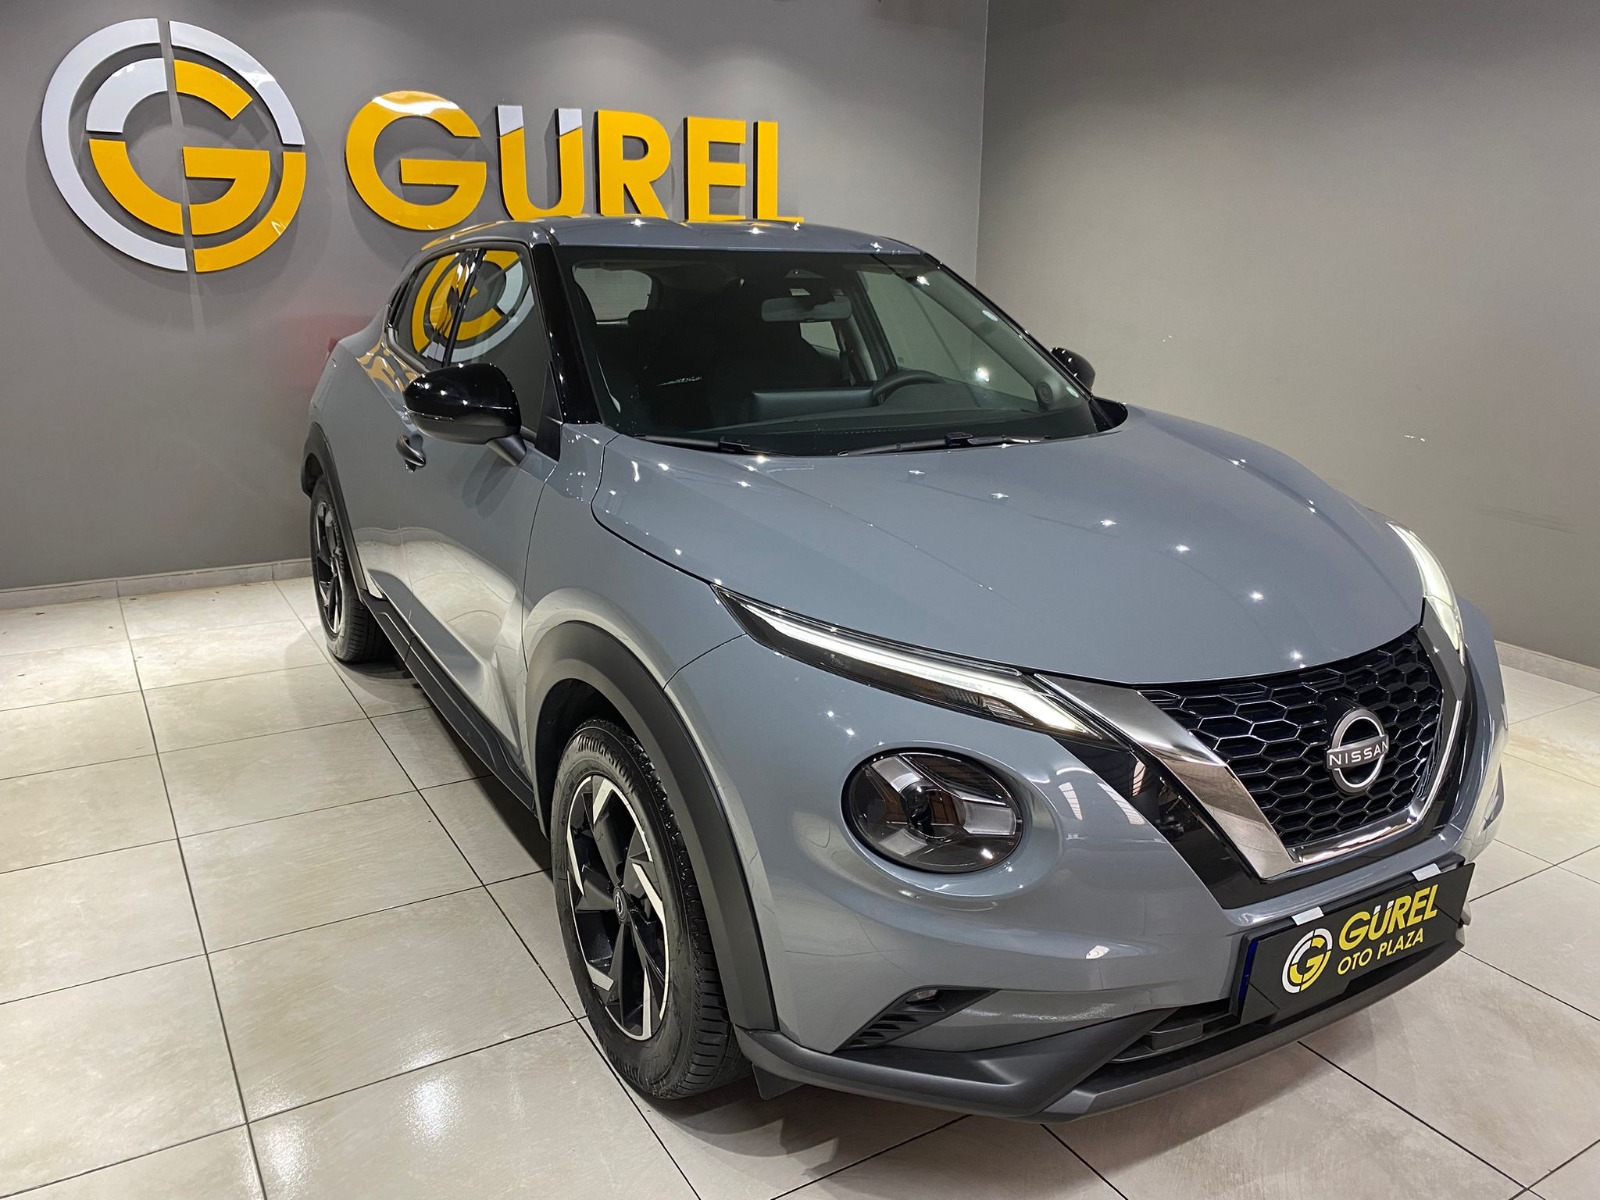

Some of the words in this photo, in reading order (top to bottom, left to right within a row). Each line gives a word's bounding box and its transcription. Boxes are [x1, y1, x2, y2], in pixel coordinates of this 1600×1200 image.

[1329, 741, 1388, 766] NISSAN
[1337, 948, 1372, 975] OTO
[1376, 927, 1424, 960] PLAZA
